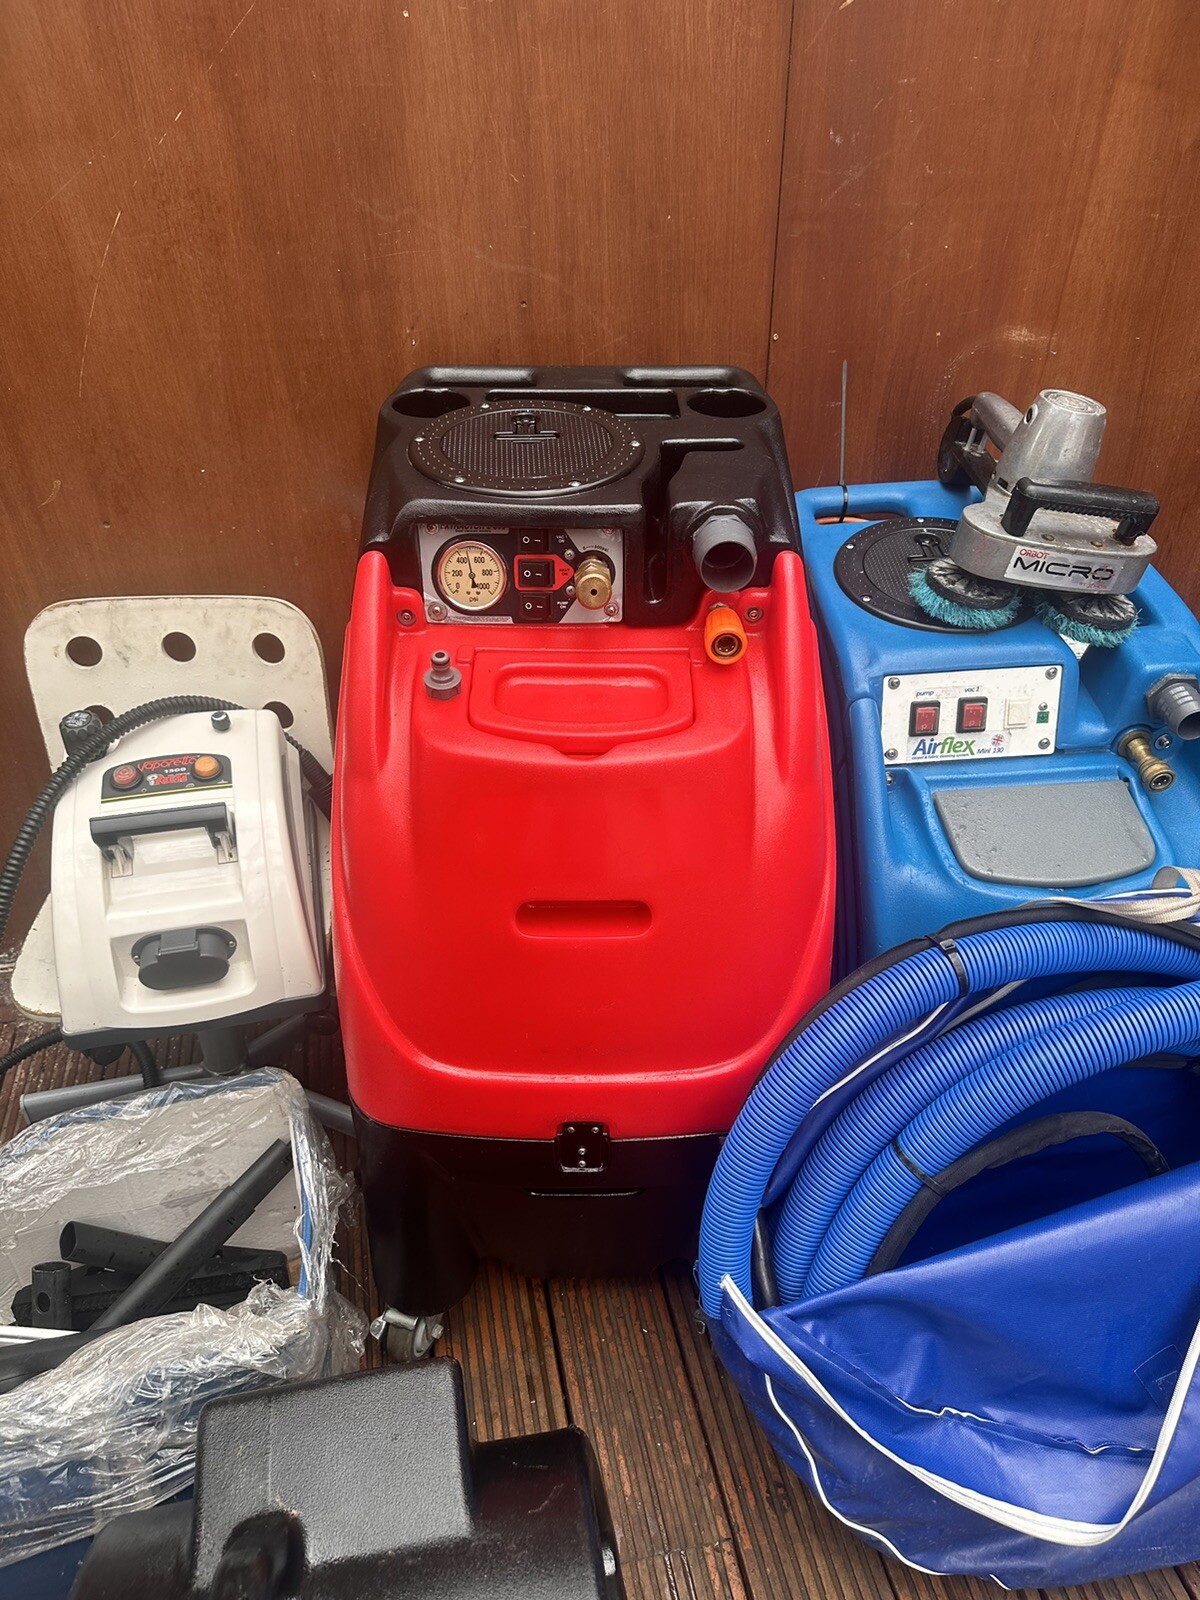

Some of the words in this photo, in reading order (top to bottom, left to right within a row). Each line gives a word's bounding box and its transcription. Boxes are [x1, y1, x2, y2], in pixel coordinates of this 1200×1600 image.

[1019, 548, 1050, 560] ORBOT
[473, 556, 485, 564] 600
[1013, 556, 1115, 580] MICRO
[482, 569, 493, 577] 800
[916, 690, 935, 699] pump
[911, 736, 976, 756] Airflex
[993, 746, 1004, 754] 130
